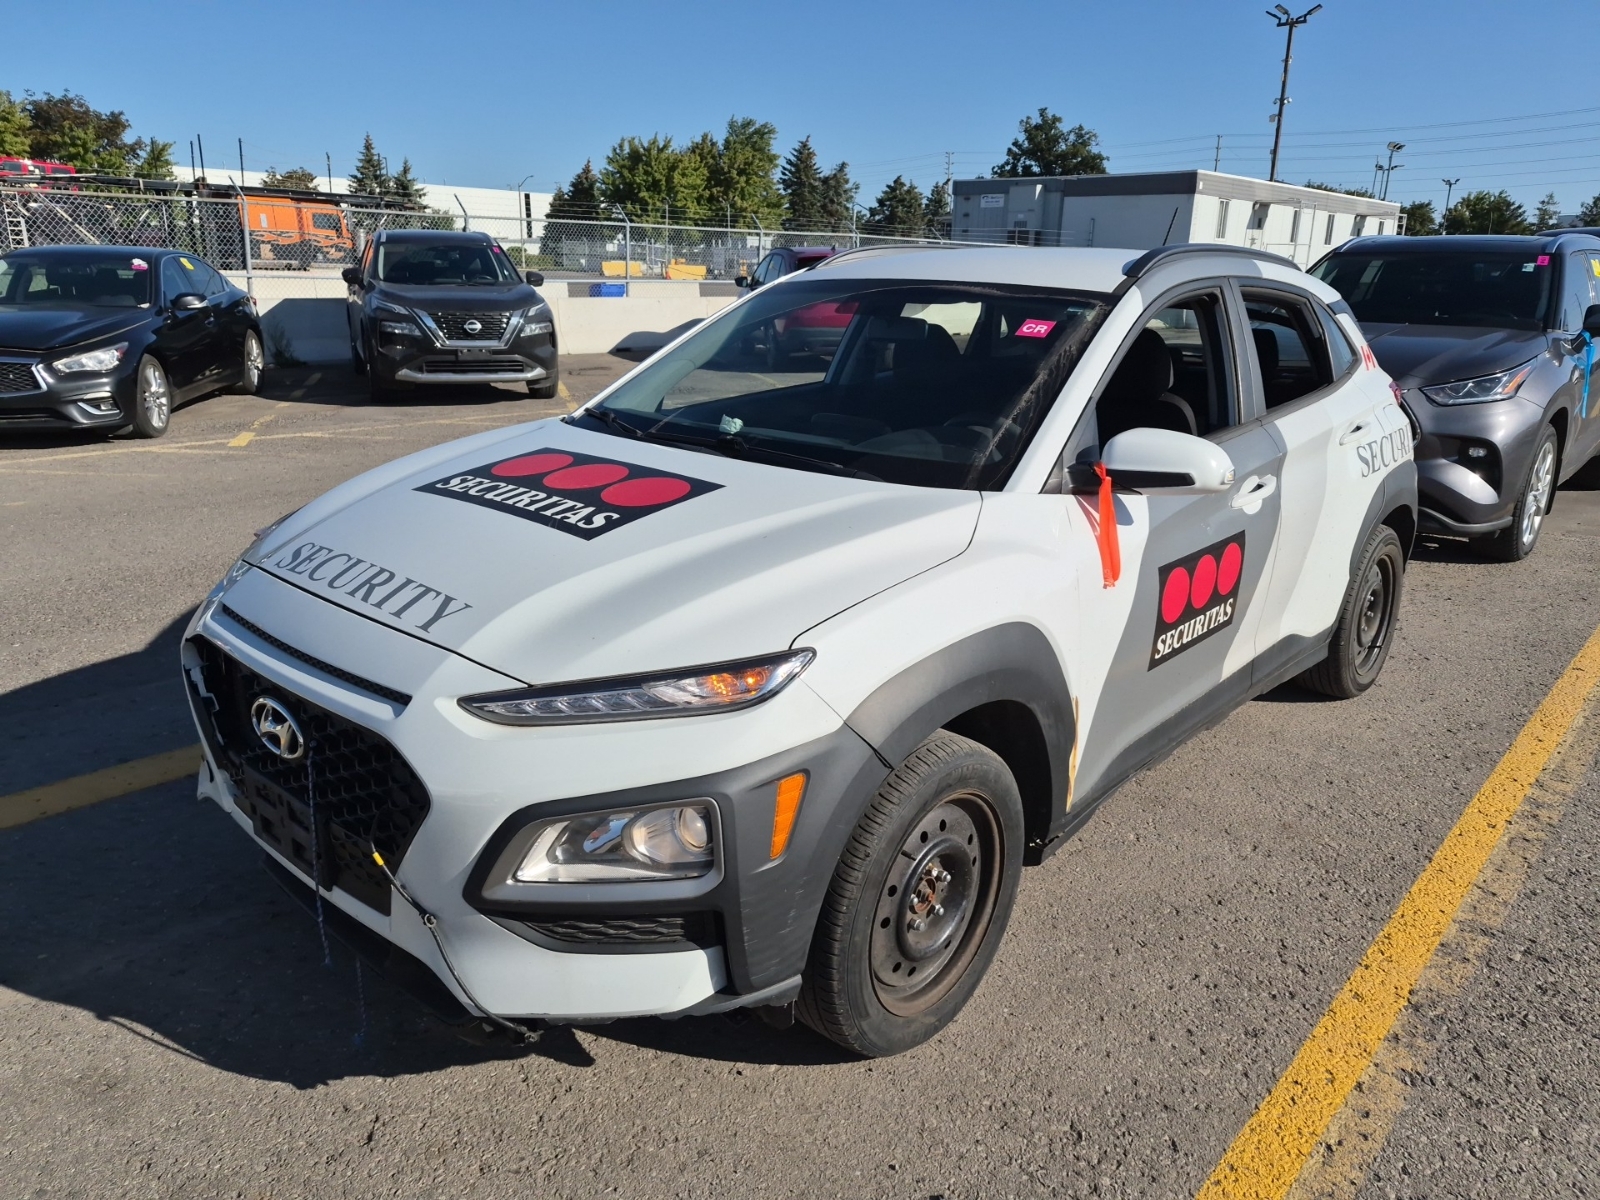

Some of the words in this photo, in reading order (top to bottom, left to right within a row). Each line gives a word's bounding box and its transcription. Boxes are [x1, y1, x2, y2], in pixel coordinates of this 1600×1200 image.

[1022, 323, 1048, 334] CR
[1356, 423, 1412, 478] SECURI
[435, 475, 621, 529] SECURITAS
[274, 542, 473, 634] SECURITY
[1154, 598, 1234, 660] SECURITAS
